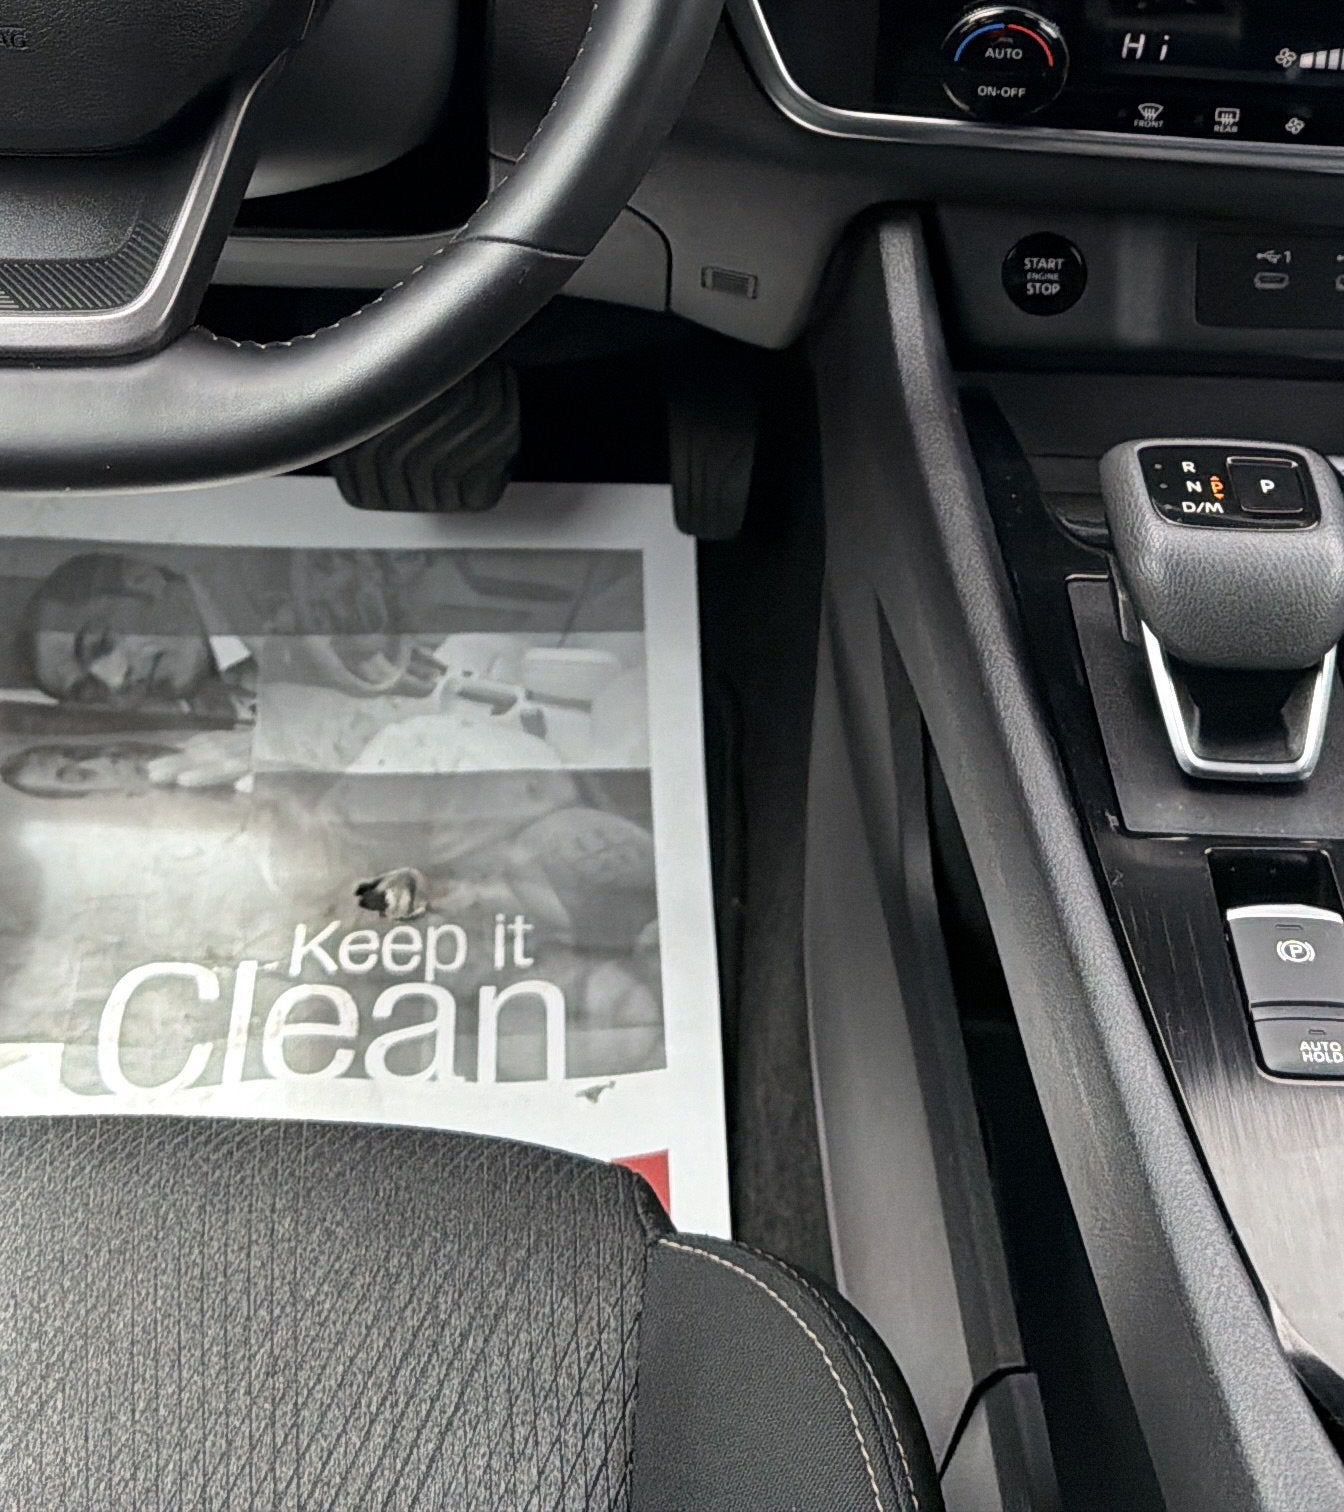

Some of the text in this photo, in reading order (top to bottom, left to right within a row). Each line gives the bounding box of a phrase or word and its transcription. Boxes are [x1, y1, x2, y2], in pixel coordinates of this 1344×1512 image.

[984, 47, 1023, 60] AUTO
[1282, 249, 1292, 263] 1
[1023, 257, 1065, 270] START
[1026, 282, 1061, 296] STOP
[1181, 461, 1197, 474] R
[1186, 480, 1202, 493] N
[1259, 479, 1276, 494] P
[1181, 501, 1225, 514] D/M
[288, 914, 535, 981] Keep it
[97, 960, 567, 1095] Clean
[1299, 1040, 1343, 1052] AUTO
[1301, 1050, 1344, 1064] HOLD
